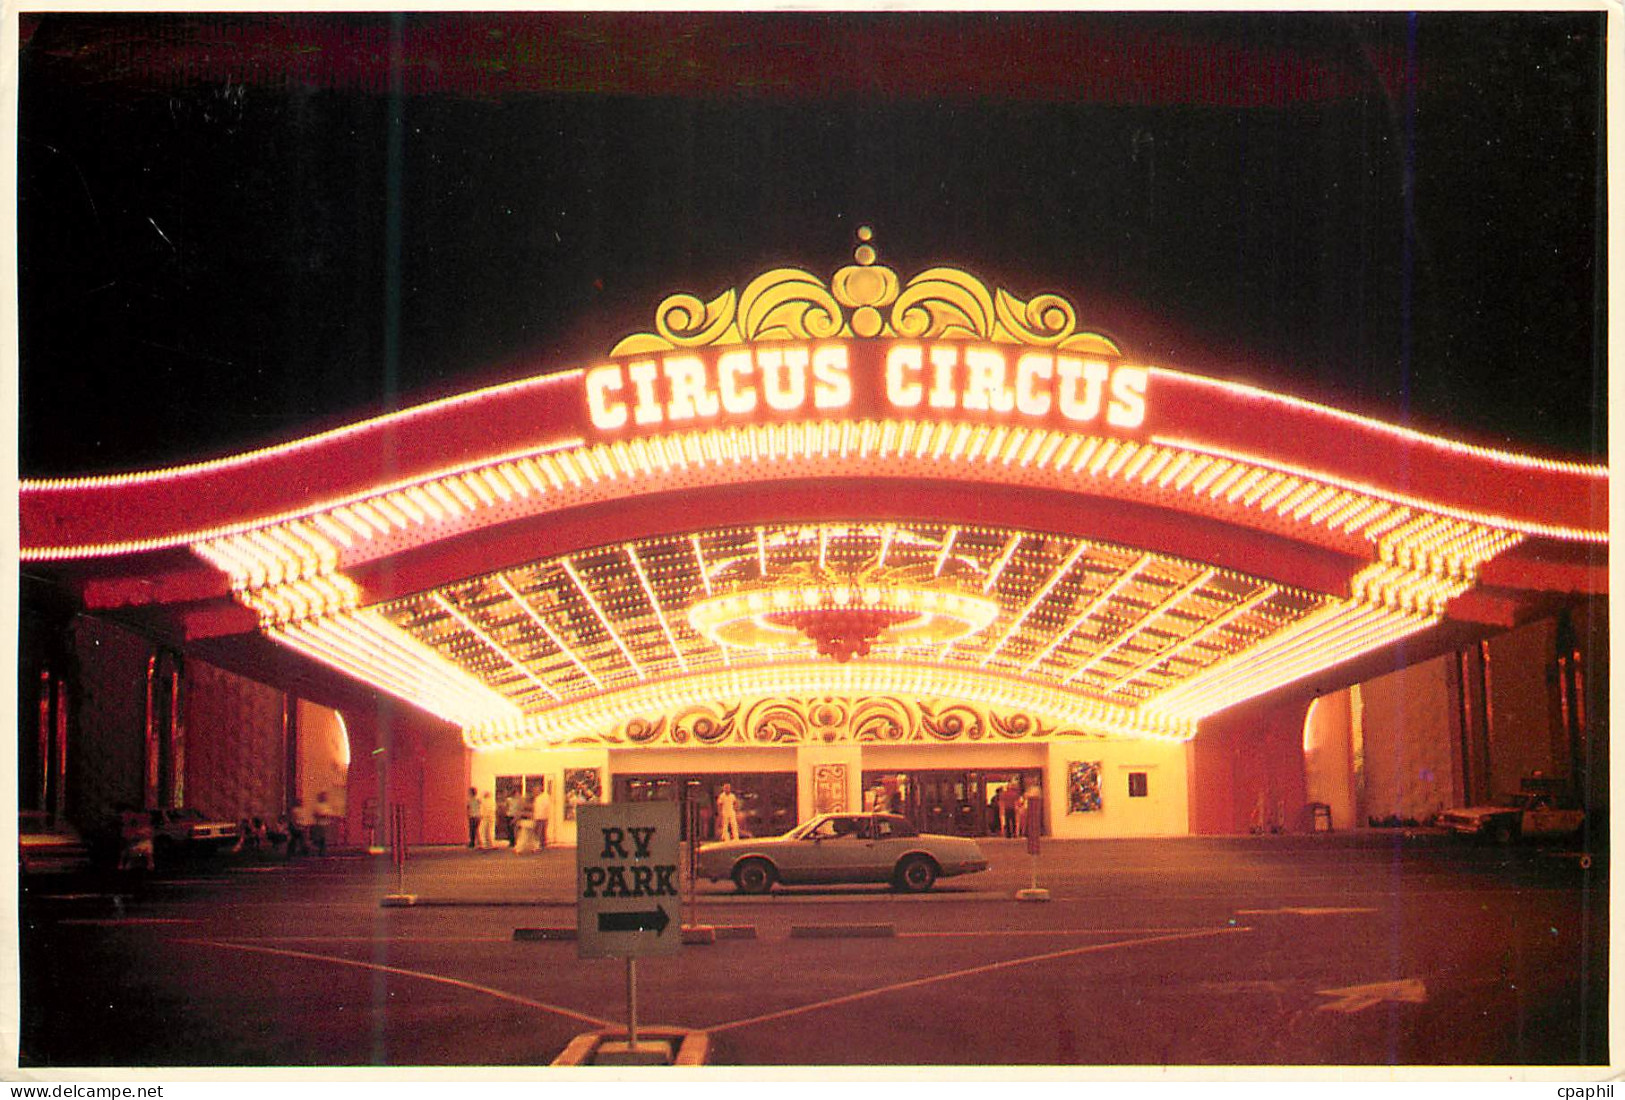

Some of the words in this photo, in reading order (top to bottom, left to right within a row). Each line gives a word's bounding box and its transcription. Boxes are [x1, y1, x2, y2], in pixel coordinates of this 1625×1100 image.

[585, 344, 853, 430] CIRCUS
[885, 343, 1148, 429] CIRCUS
[601, 827, 655, 859] RV
[583, 865, 678, 898] PARK
